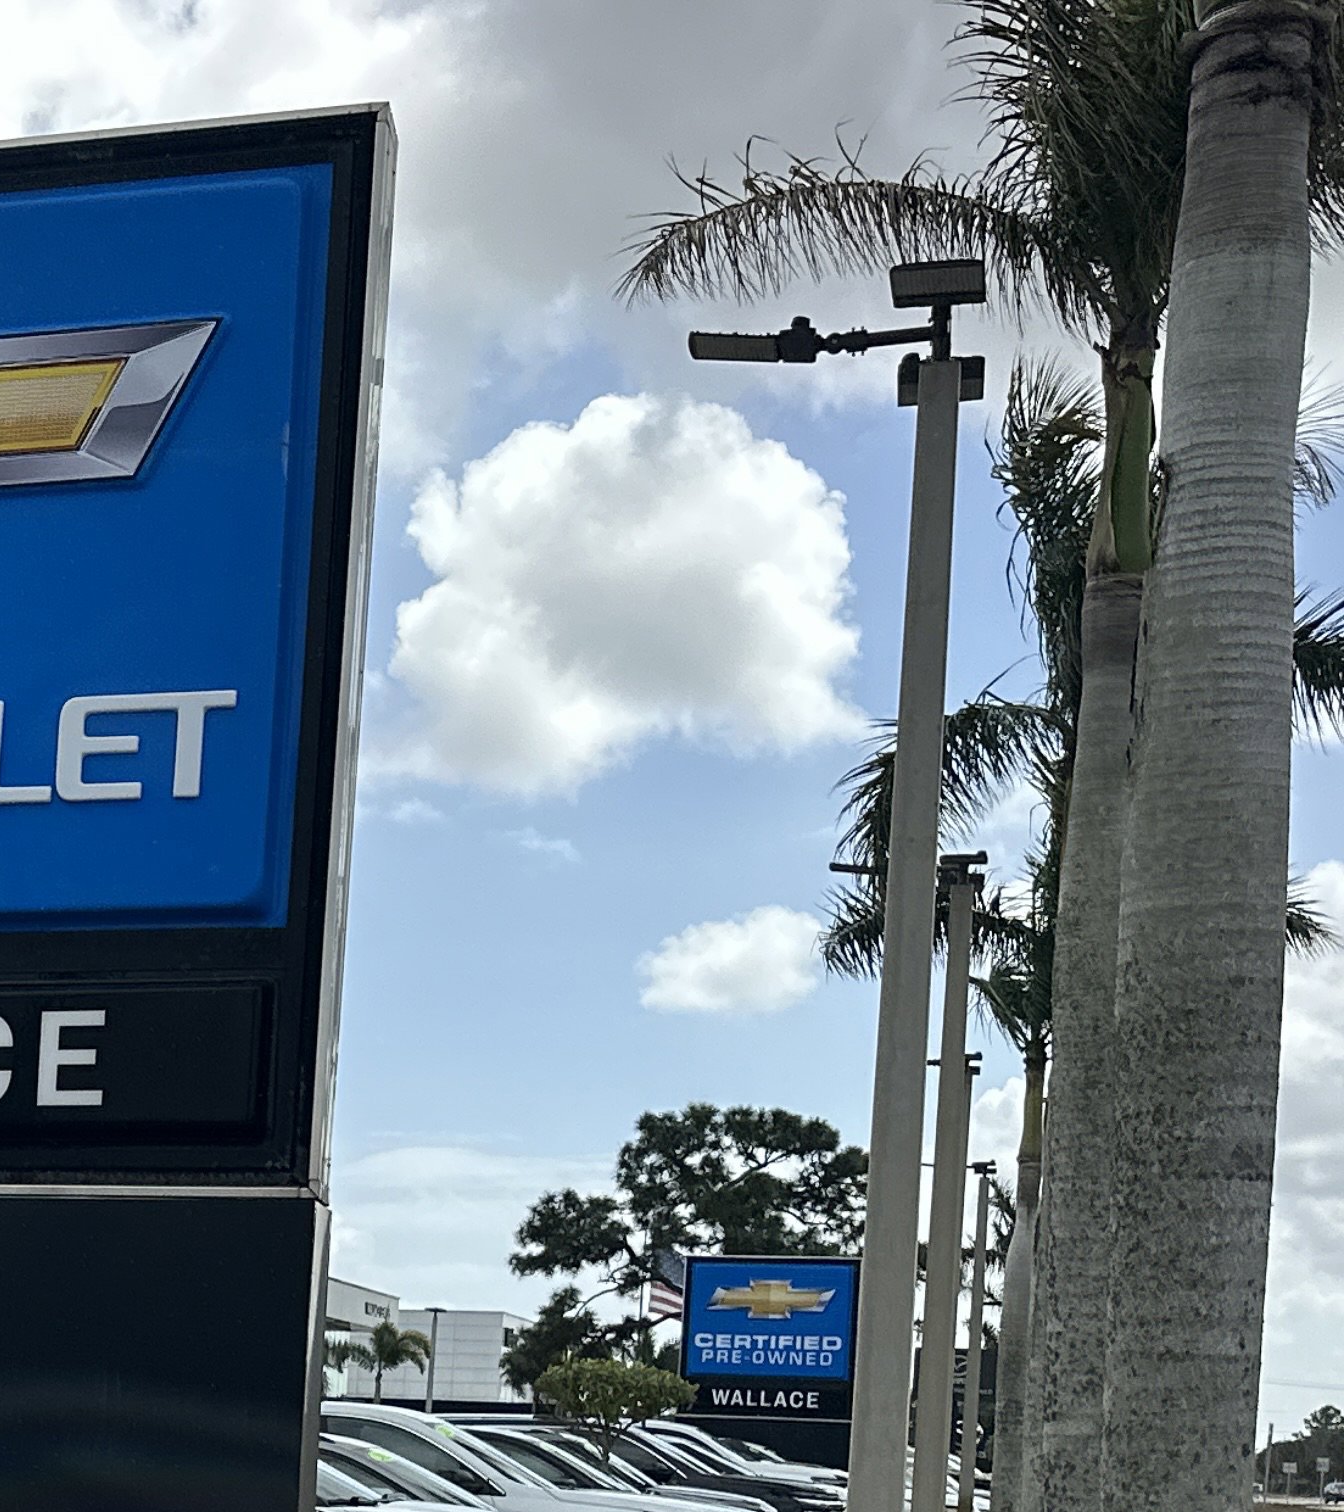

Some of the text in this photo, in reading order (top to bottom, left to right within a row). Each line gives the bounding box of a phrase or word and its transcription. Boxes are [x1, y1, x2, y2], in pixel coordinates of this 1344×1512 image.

[694, 1332, 843, 1351] CERTIFIED
[701, 1349, 833, 1367] PRE-OWNED
[711, 1388, 820, 1409] WALLACE
